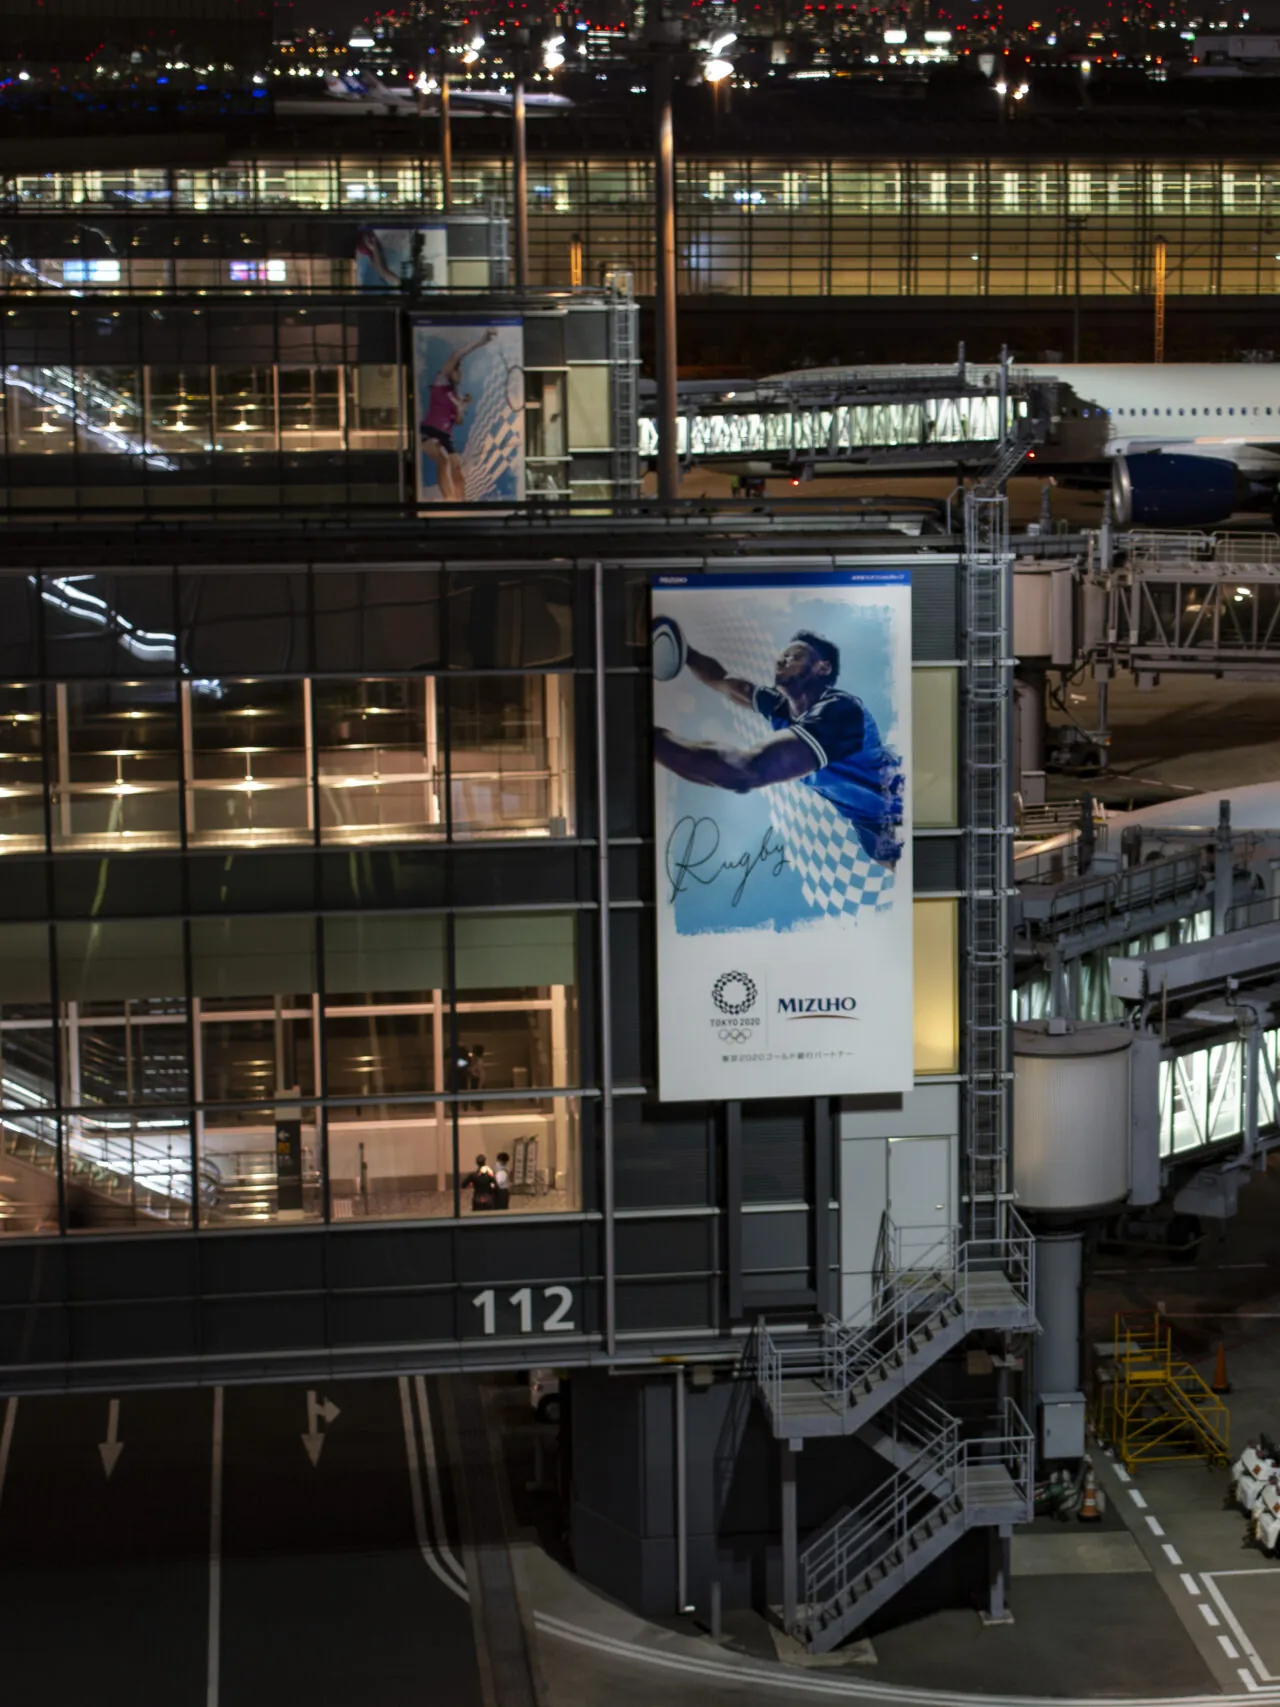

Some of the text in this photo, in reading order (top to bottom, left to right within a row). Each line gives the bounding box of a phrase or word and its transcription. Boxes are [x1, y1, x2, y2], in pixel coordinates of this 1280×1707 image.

[666, 815, 791, 907] Rugby
[777, 996, 857, 1013] MIZUHO
[710, 1017, 760, 1027] TOKYO 2020
[472, 1285, 575, 1334] 112
